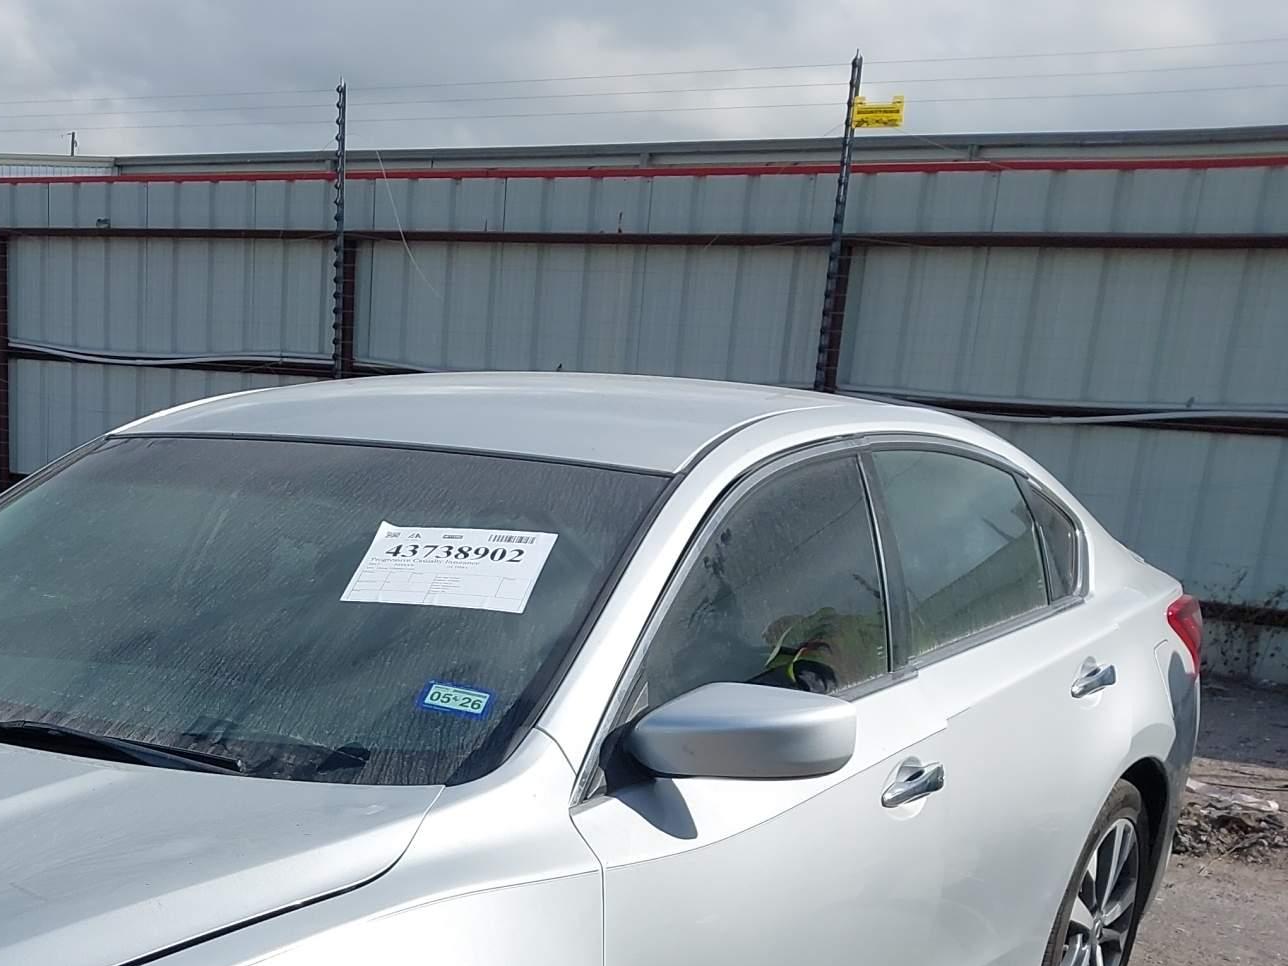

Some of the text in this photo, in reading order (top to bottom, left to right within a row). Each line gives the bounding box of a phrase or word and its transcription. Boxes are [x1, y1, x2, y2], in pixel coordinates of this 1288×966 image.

[385, 544, 525, 563] 43738902
[429, 691, 483, 710] 05 26
